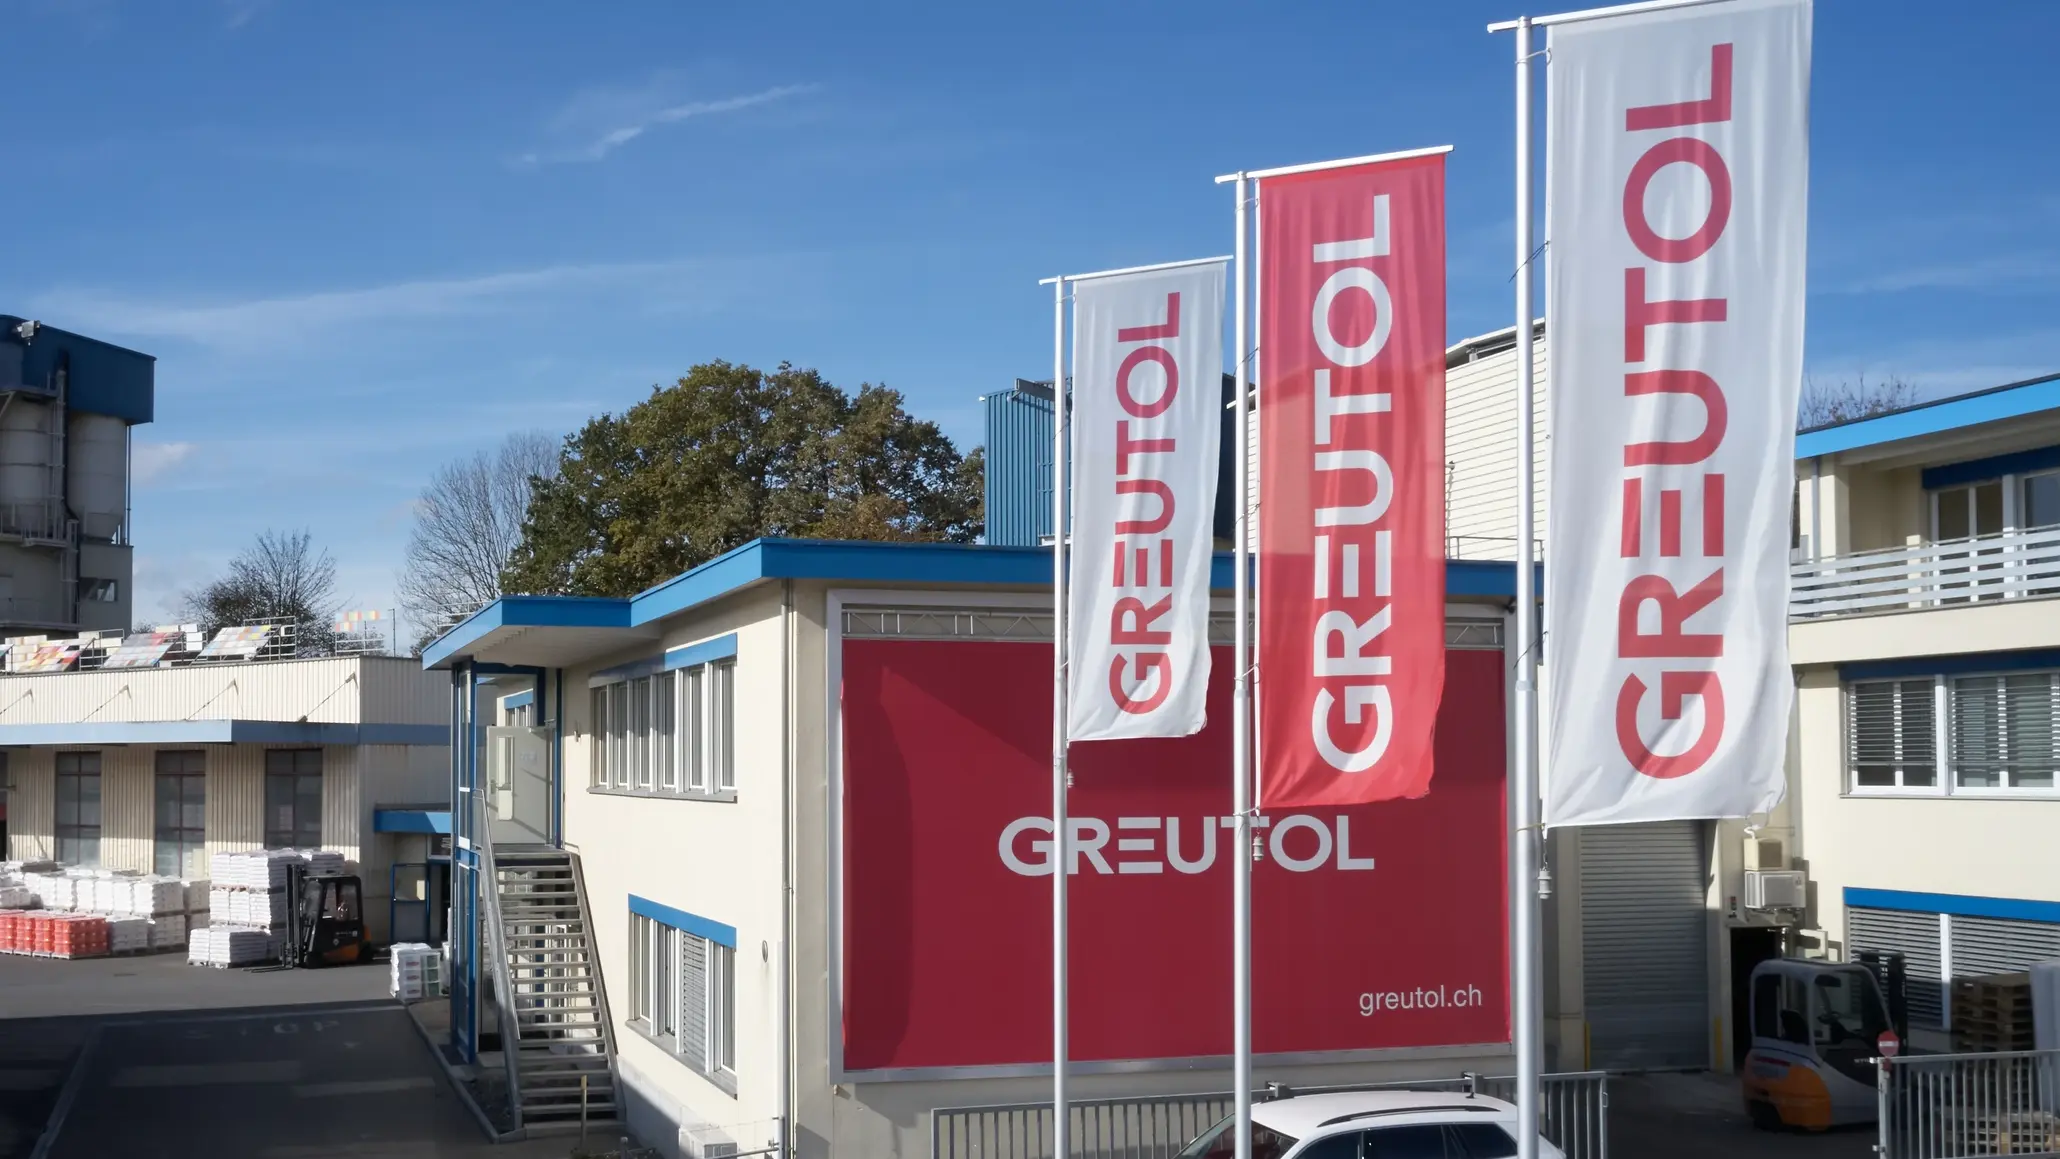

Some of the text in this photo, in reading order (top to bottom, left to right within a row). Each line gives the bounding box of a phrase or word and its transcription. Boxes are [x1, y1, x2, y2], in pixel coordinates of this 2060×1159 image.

[1109, 291, 1180, 715] GREUTOL
[1312, 194, 1394, 773] GREUTOL
[1616, 42, 1733, 780] GREUTOL
[1359, 983, 1482, 1017] greutol.ch
